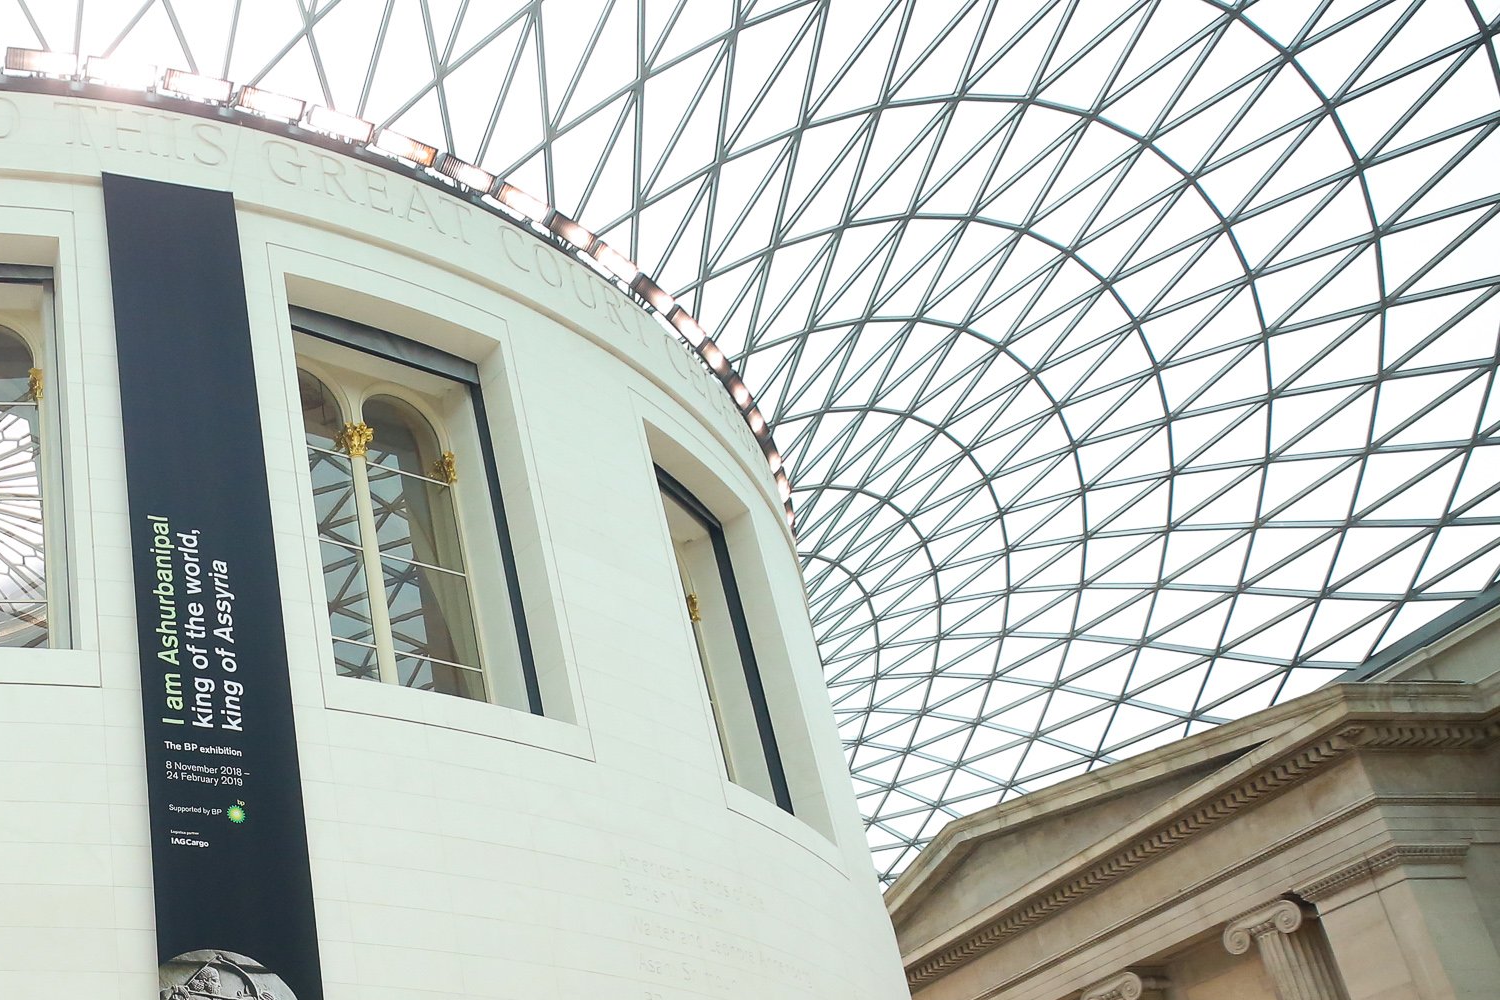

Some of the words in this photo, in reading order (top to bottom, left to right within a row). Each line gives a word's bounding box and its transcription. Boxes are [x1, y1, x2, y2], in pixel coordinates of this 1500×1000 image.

[54, 102, 231, 167] THIS
[261, 138, 475, 246] GREAT
[498, 224, 654, 349] COURT
[176, 529, 202, 594] world,
[147, 515, 180, 665] Ashurbanipal
[208, 559, 235, 644] Assyria
[184, 602, 206, 640] the
[186, 644, 209, 670] of
[215, 647, 238, 672] of
[165, 673, 185, 710] am
[192, 677, 215, 728] king
[222, 680, 244, 731] king
[164, 740, 182, 751] The
[184, 742, 198, 752] BP
[199, 745, 242, 757] exhibition
[165, 760, 173, 770] 8
[174, 762, 219, 774] November
[220, 765, 242, 777] 2018
[166, 771, 179, 780] 24
[181, 773, 219, 787] February
[221, 776, 243, 787] 2019
[168, 803, 202, 814] Supported
[202, 807, 211, 816] by
